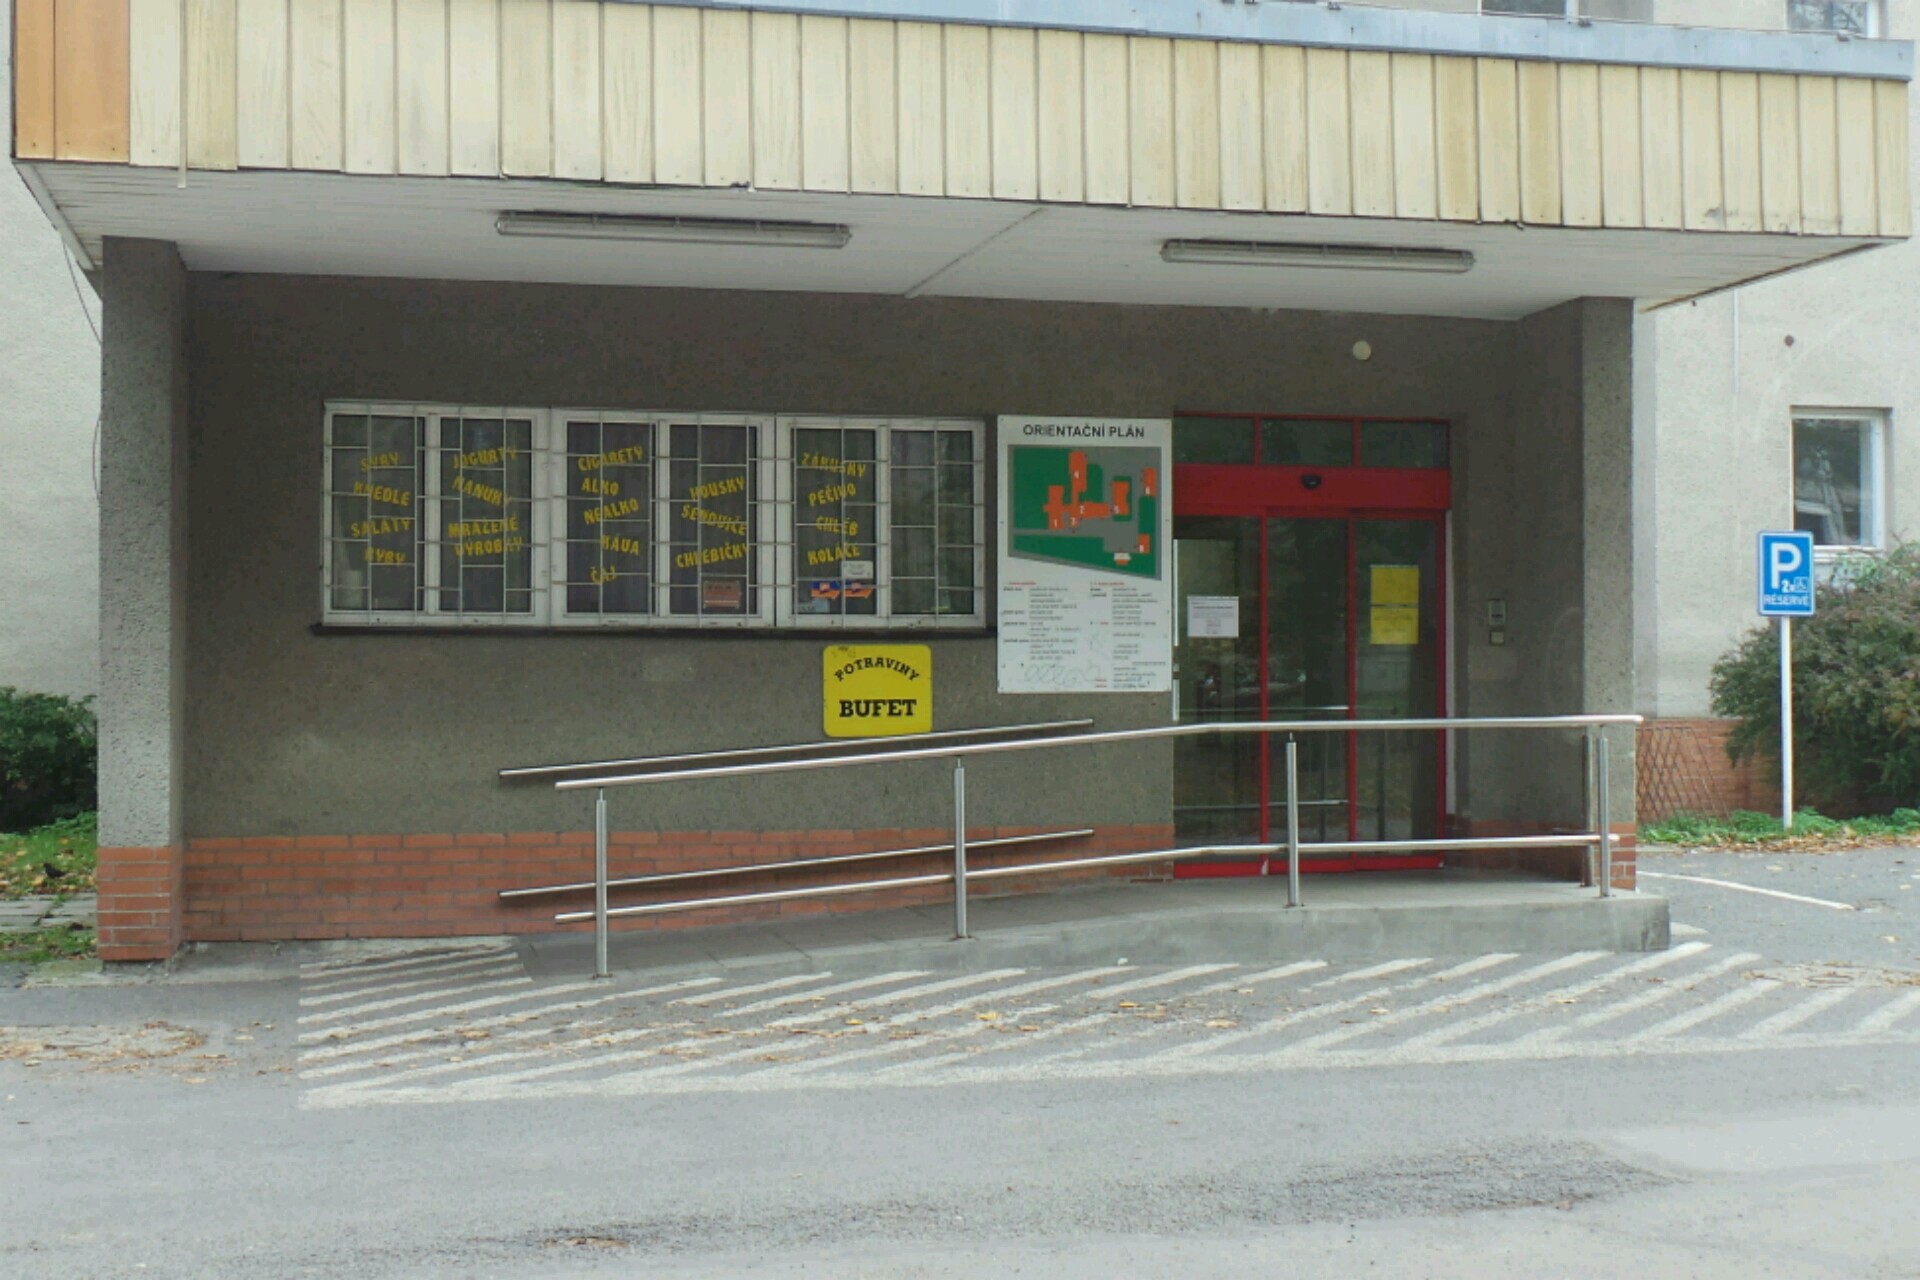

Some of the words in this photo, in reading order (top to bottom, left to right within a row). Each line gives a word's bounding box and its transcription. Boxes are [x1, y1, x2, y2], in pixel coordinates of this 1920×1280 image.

[1022, 423, 1105, 438] ORIENTAČNÍ
[1109, 424, 1145, 439] PLÁN
[577, 446, 643, 471] CIGARETY
[581, 477, 620, 496] ALKO
[688, 475, 745, 500] HOUSKY
[583, 498, 639, 525] NEALKO
[1770, 542, 1802, 589] P
[833, 656, 920, 682] POTRAVINY
[839, 699, 917, 718] BUFET
